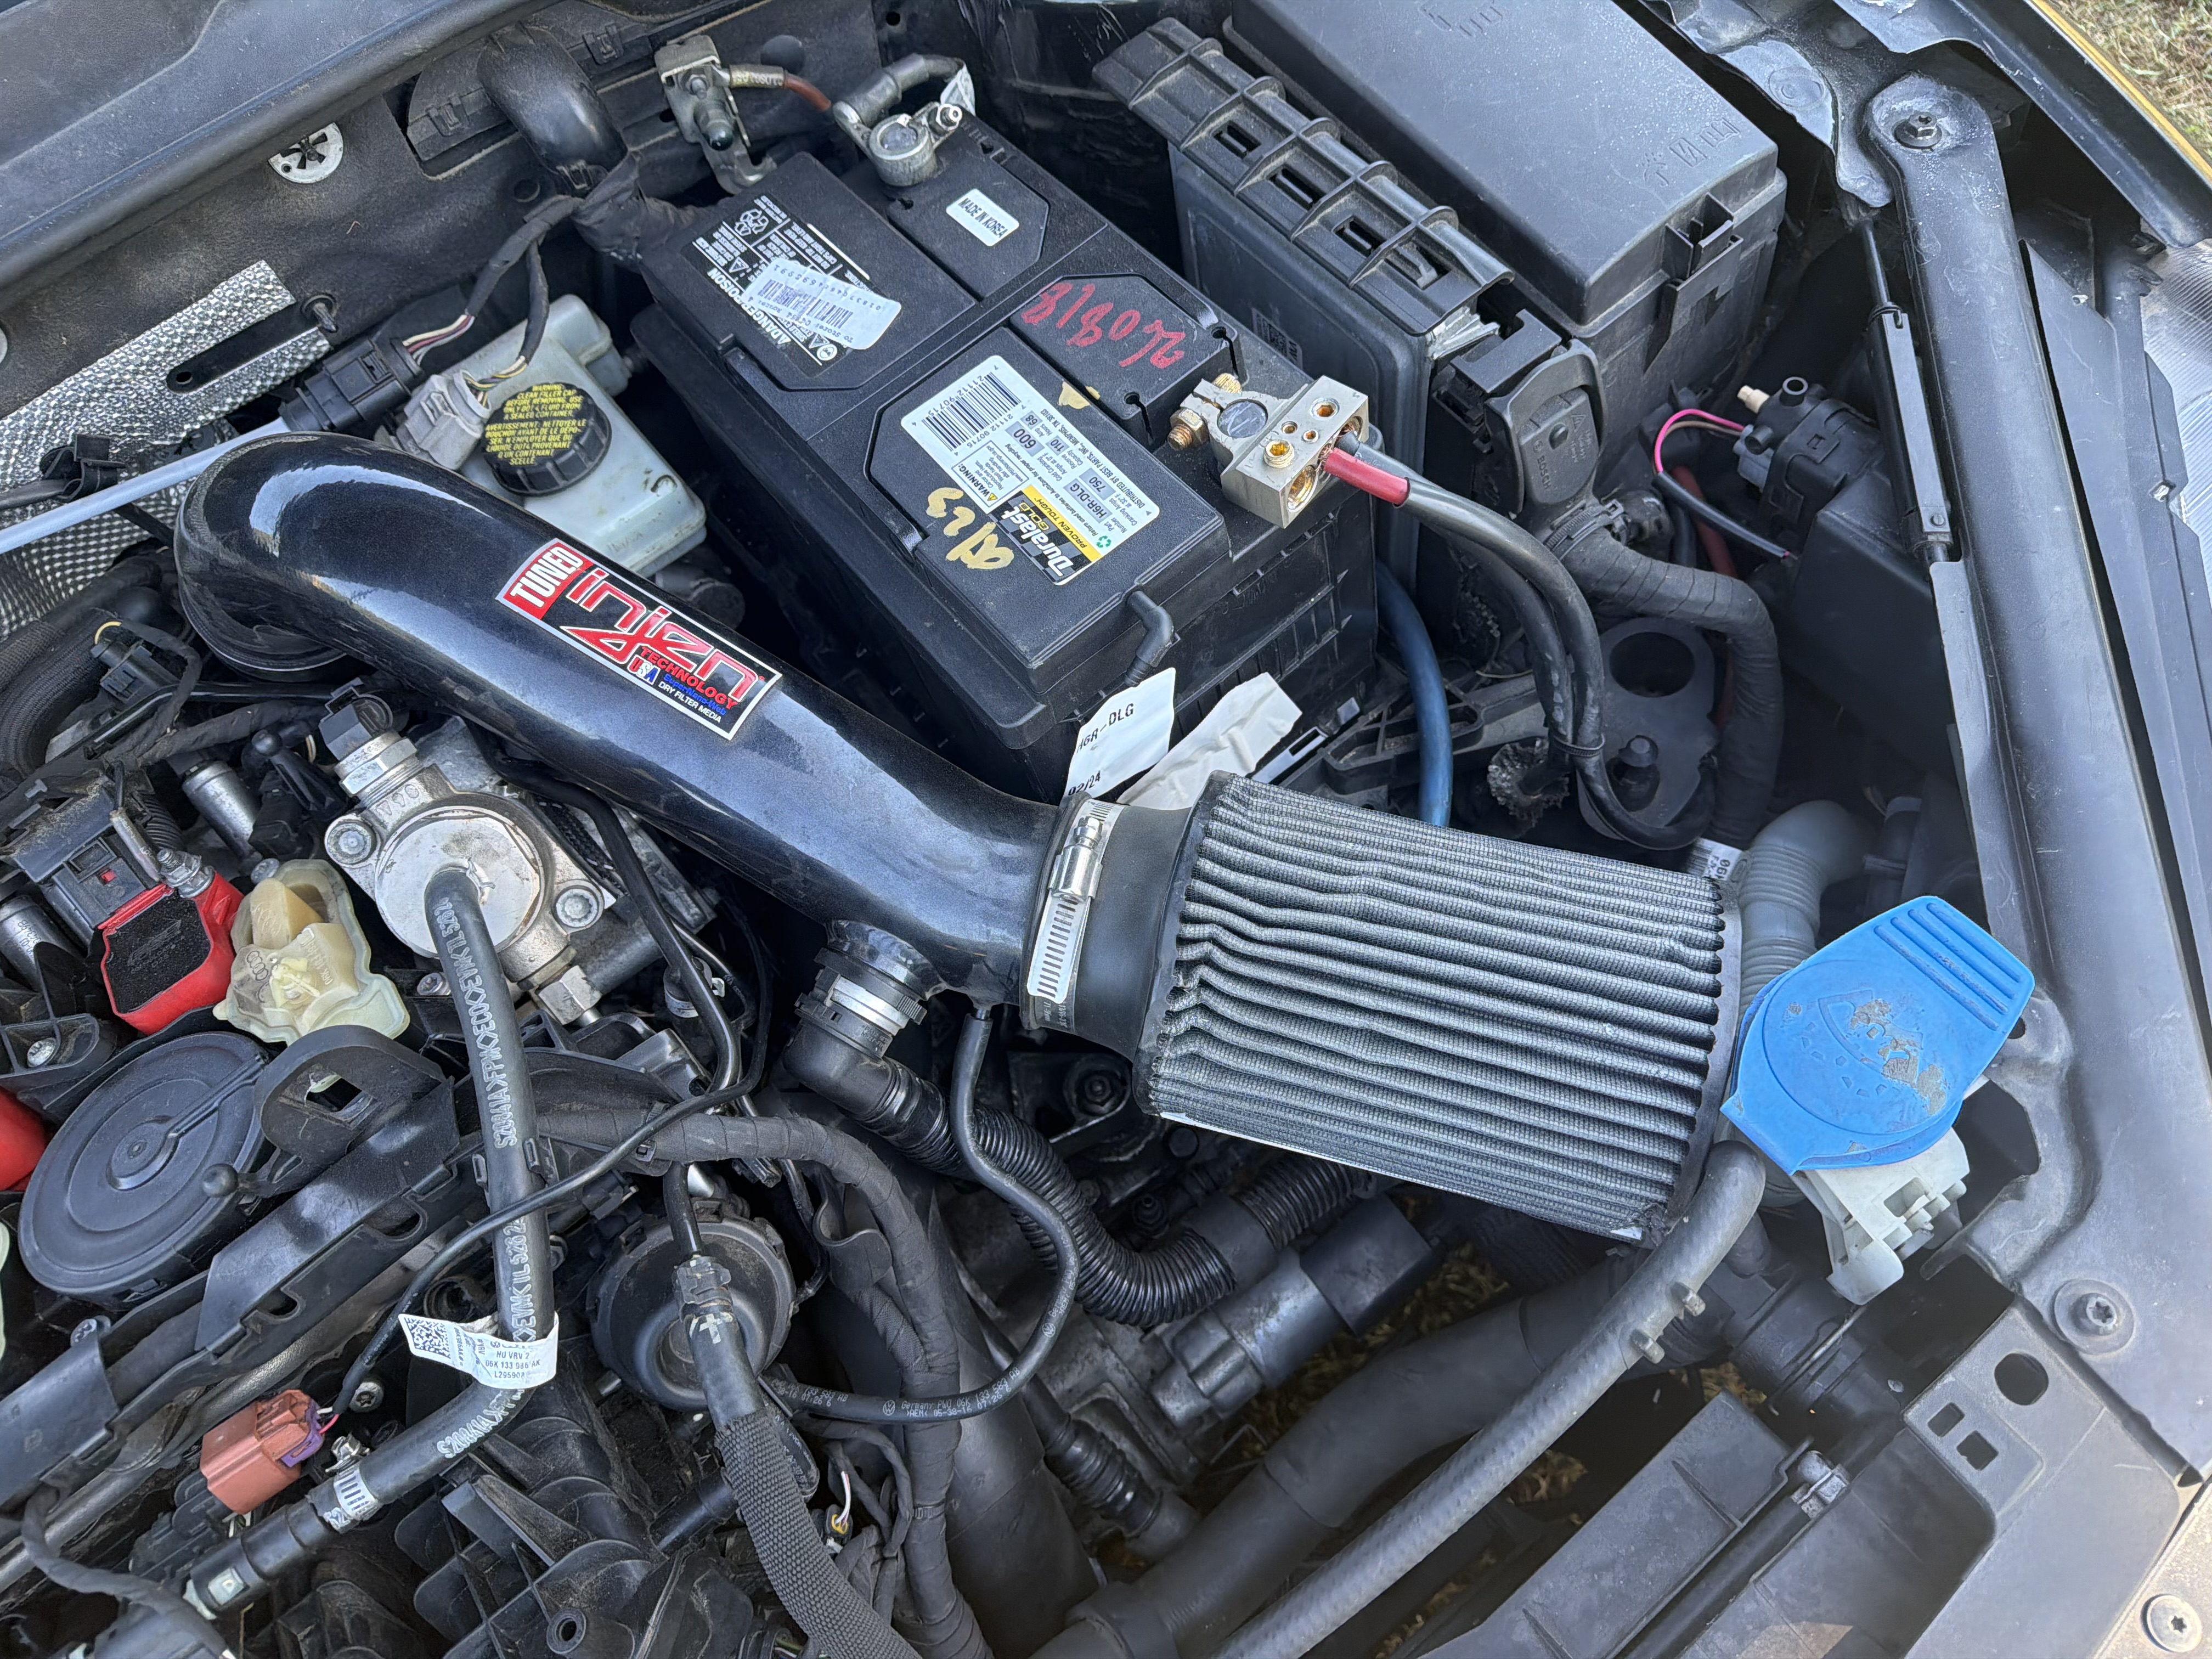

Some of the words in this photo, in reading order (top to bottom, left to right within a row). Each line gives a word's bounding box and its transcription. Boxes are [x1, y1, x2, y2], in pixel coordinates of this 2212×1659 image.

[957, 197, 983, 217] MADE
[974, 210, 990, 223] IN
[981, 216, 1009, 238] KOREA
[1022, 413, 1039, 427] 68
[1011, 426, 1038, 450] 600
[1032, 426, 1046, 438] Amp
[1003, 442, 1024, 461] recycling
[1048, 437, 1066, 453] 110
[1019, 458, 1035, 472] proper
[1035, 455, 1056, 474] Cranking
[1059, 453, 1077, 470] Reserve
[1065, 448, 1085, 466] Capacity
[1029, 469, 1040, 478] for
[1050, 470, 1063, 482] Cold
[1053, 461, 1068, 475] Amps
[1098, 465, 1114, 478] BEST
[1536, 455, 1552, 490] BOSCH
[955, 462, 991, 497] WARNING:
[1035, 475, 1057, 495] AutoZone
[1087, 475, 1107, 493] 750
[1109, 475, 1120, 484] BY
[1068, 482, 1108, 519] H6R-DLG
[1107, 496, 1123, 511] Amps
[1115, 480, 1146, 509] DISTRIBUTED
[1057, 496, 1077, 515] batteries
[1017, 500, 1051, 532] GOLD
[1073, 512, 1086, 523] used
[1109, 516, 1128, 534] Number
[1118, 507, 1139, 527] Cranking
[1057, 520, 1088, 549] PROVEN
[1081, 521, 1099, 537] Return
[1102, 520, 1115, 532] Part
[999, 503, 1076, 577] Duralast
[510, 545, 584, 608] TUNED
[560, 567, 761, 702] injen
[626, 657, 662, 685] USA
[641, 645, 738, 710] TECHNOLOGY
[657, 680, 676, 695] DRY
[673, 690, 700, 709] FILTER
[697, 704, 724, 724] MEDIA
[663, 673, 729, 715] SuperNano-Web
[531, 1359, 540, 1367] AK
[900, 1400, 934, 1412] Germany
[954, 1393, 972, 1410] 06K
[974, 1388, 991, 1403] 133
[1007, 1365, 1022, 1380] AB
